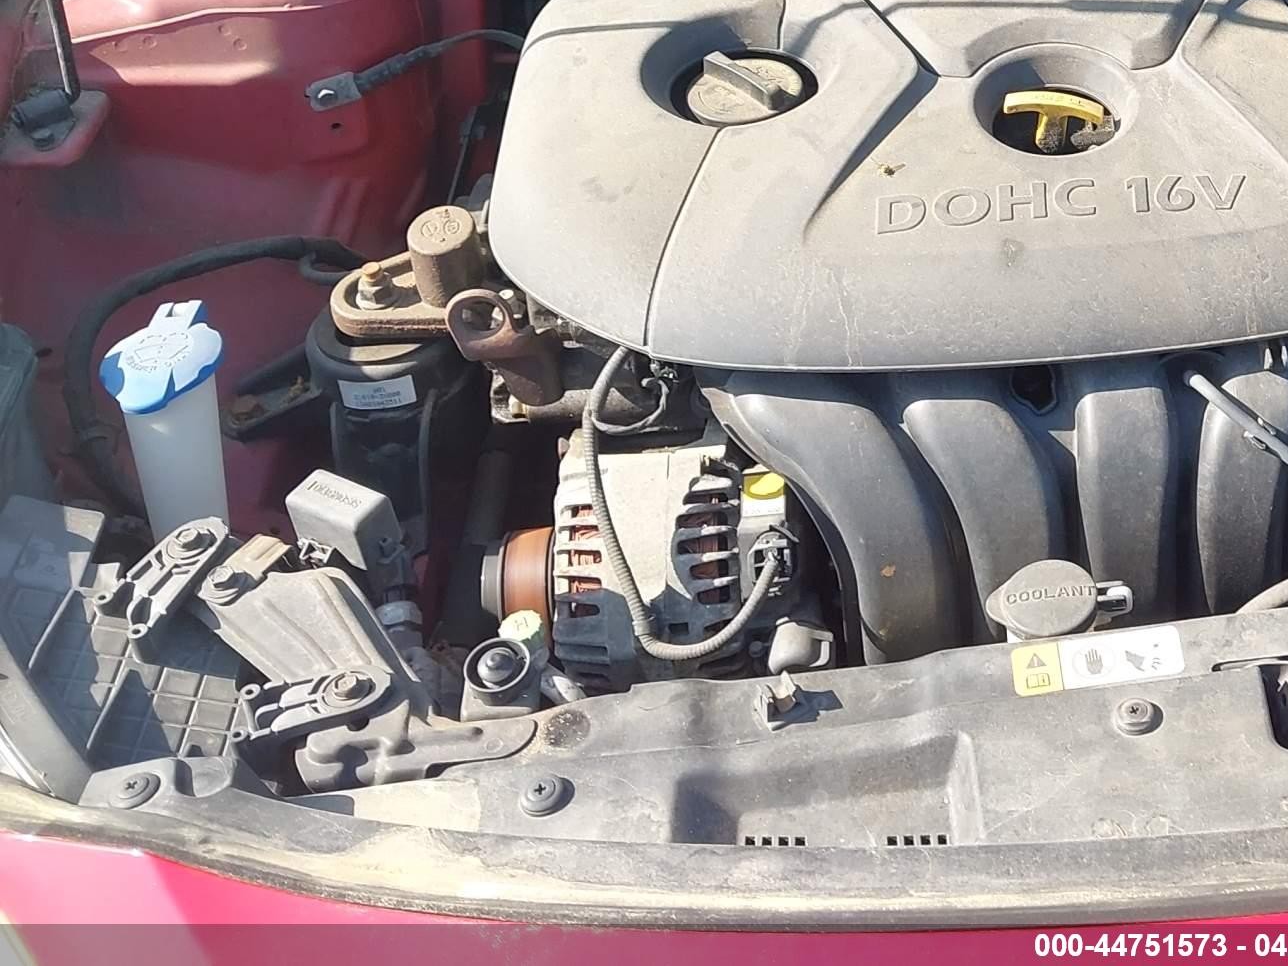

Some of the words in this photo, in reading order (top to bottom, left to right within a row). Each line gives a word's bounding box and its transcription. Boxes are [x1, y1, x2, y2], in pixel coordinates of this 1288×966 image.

[875, 178, 1098, 235] DOHC
[1125, 174, 1248, 213] 16V
[1005, 585, 1097, 606] COOLANT
